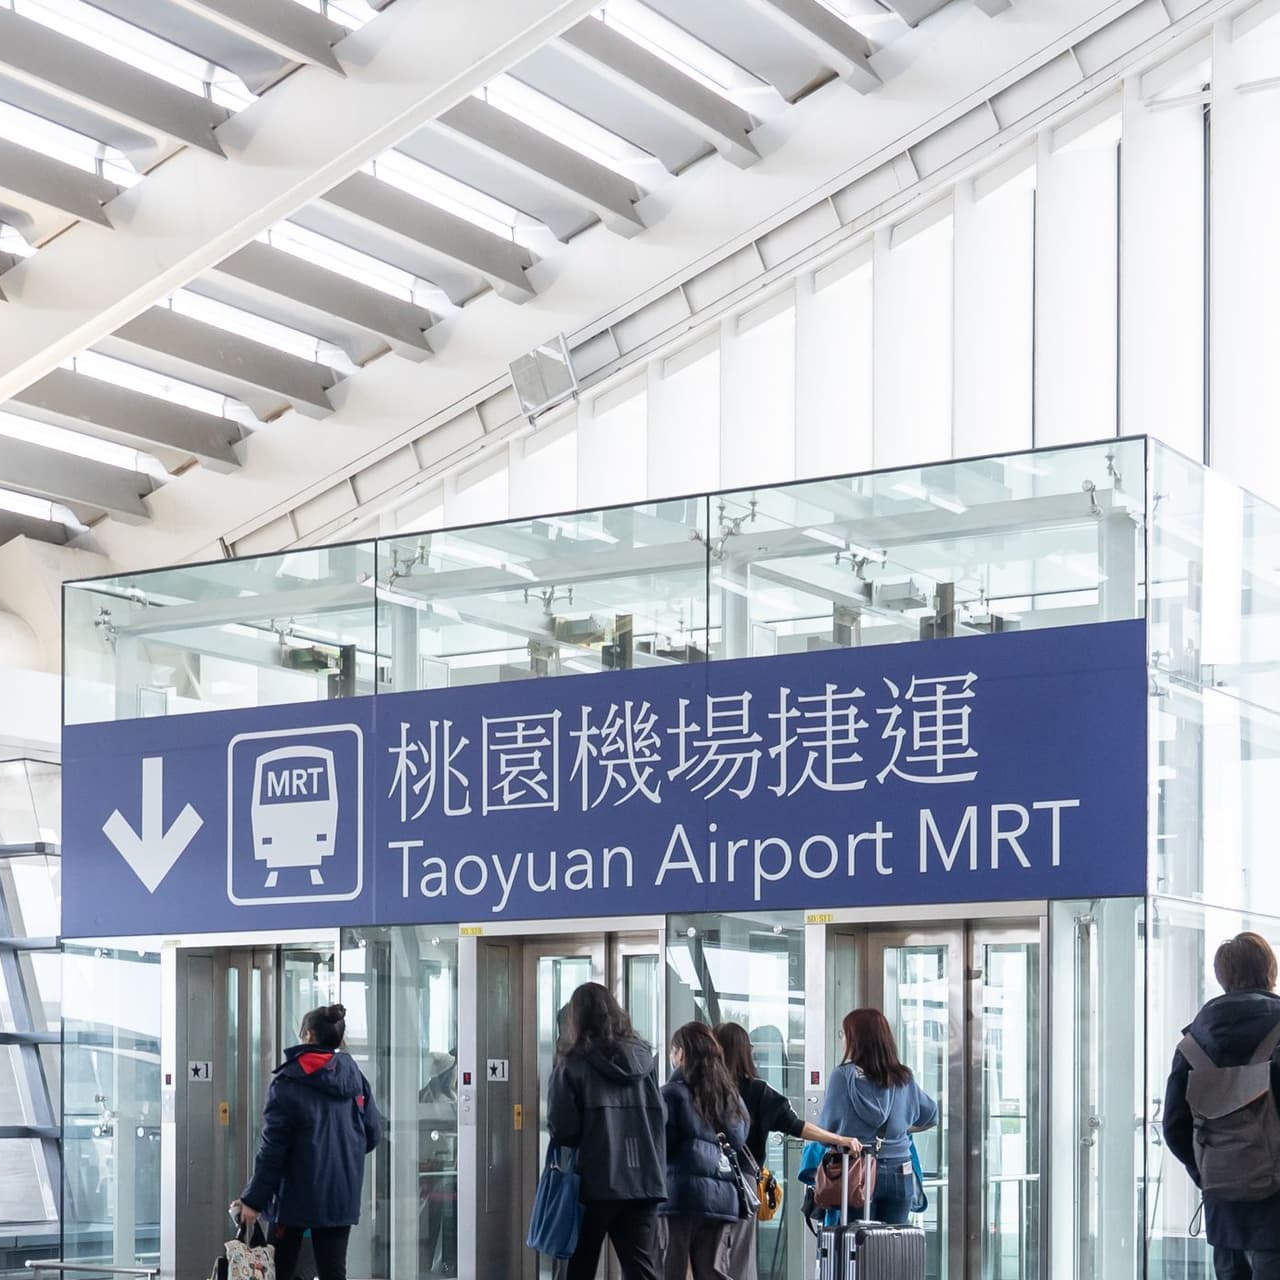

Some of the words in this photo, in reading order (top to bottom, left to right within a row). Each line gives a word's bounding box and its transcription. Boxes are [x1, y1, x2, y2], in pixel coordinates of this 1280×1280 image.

[268, 768, 323, 797] MRT
[387, 671, 979, 822] 桃園機場捷運
[389, 840, 632, 912] Taoyuan
[655, 822, 892, 900] Airport
[920, 800, 1079, 872] MRT
